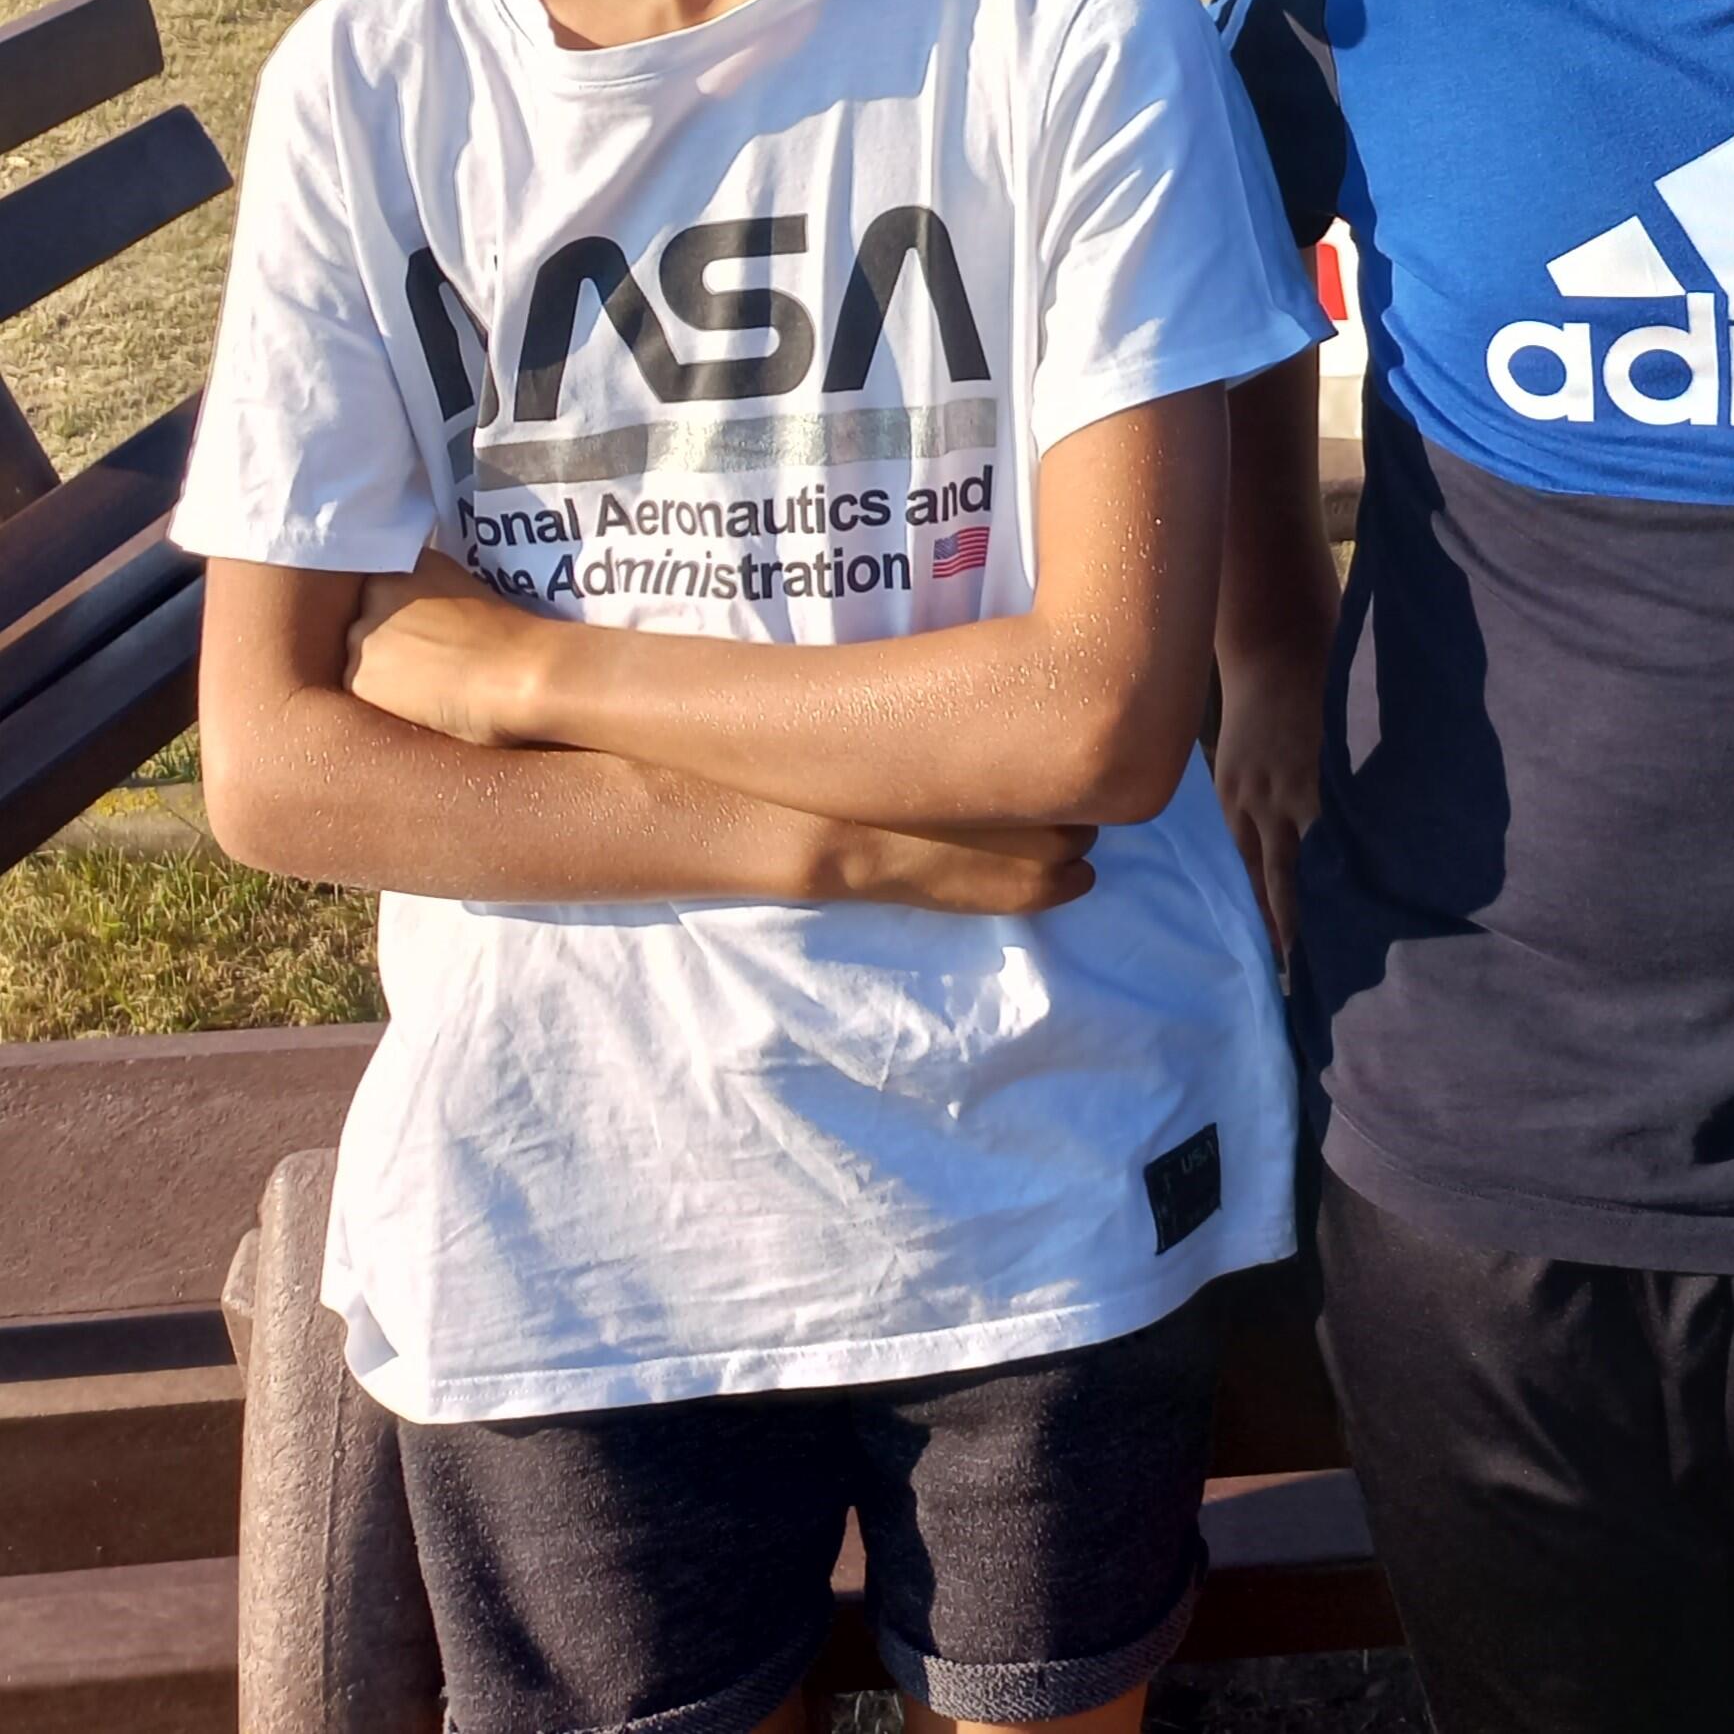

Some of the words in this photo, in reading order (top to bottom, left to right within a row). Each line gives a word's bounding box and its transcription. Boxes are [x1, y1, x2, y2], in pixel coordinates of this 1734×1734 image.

[595, 484, 891, 538] Aeronautics
[905, 465, 993, 526] and
[546, 547, 912, 602] Administration
